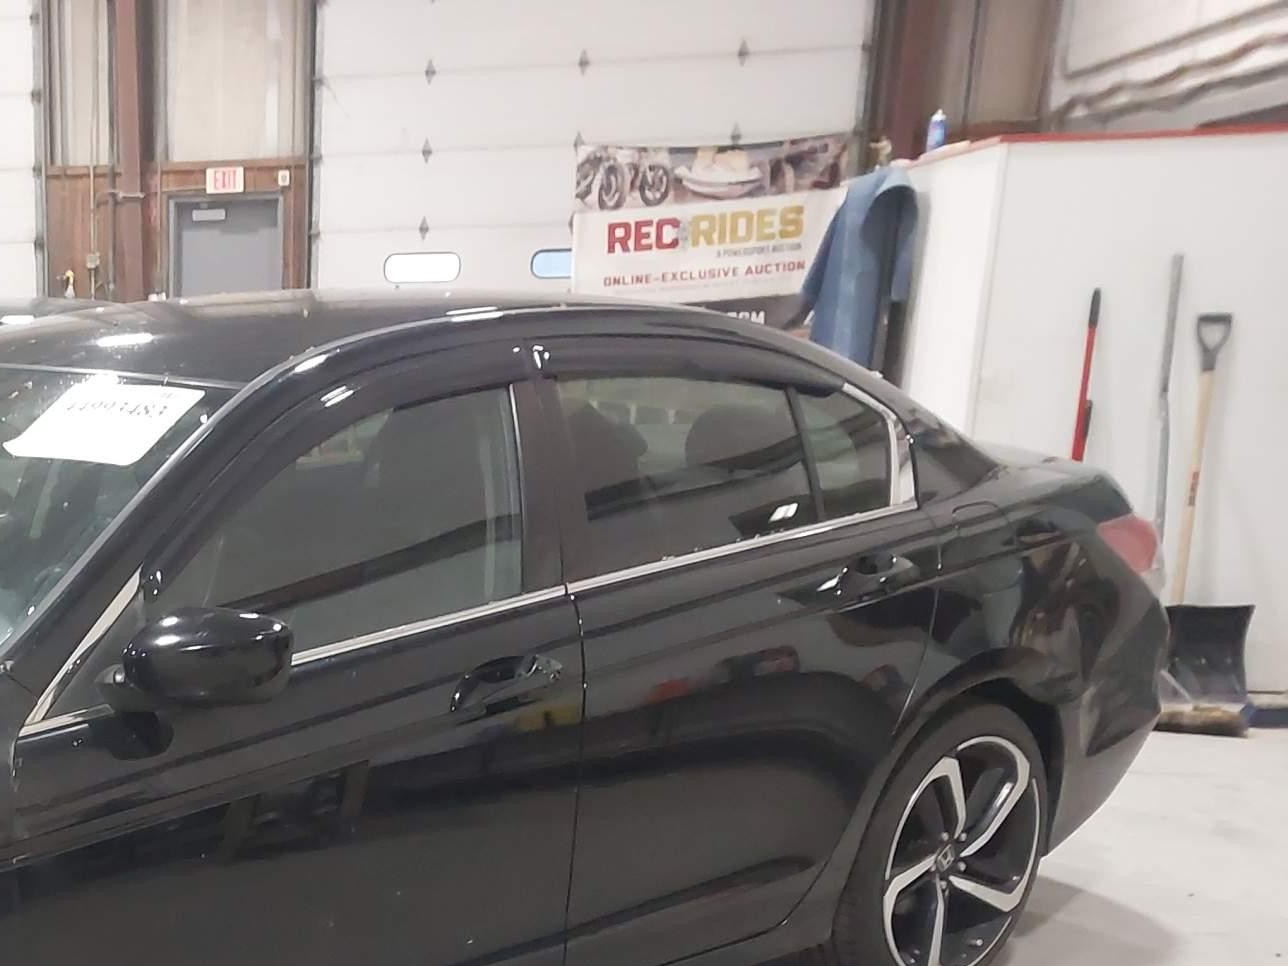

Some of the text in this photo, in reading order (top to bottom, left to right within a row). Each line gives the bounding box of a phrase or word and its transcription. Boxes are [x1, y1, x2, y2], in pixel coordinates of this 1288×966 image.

[213, 169, 237, 191] EXIT
[606, 205, 805, 255] REC RIDES
[603, 266, 739, 288] ONLINE-EXCLUSIVE
[744, 260, 806, 277] AUCTION
